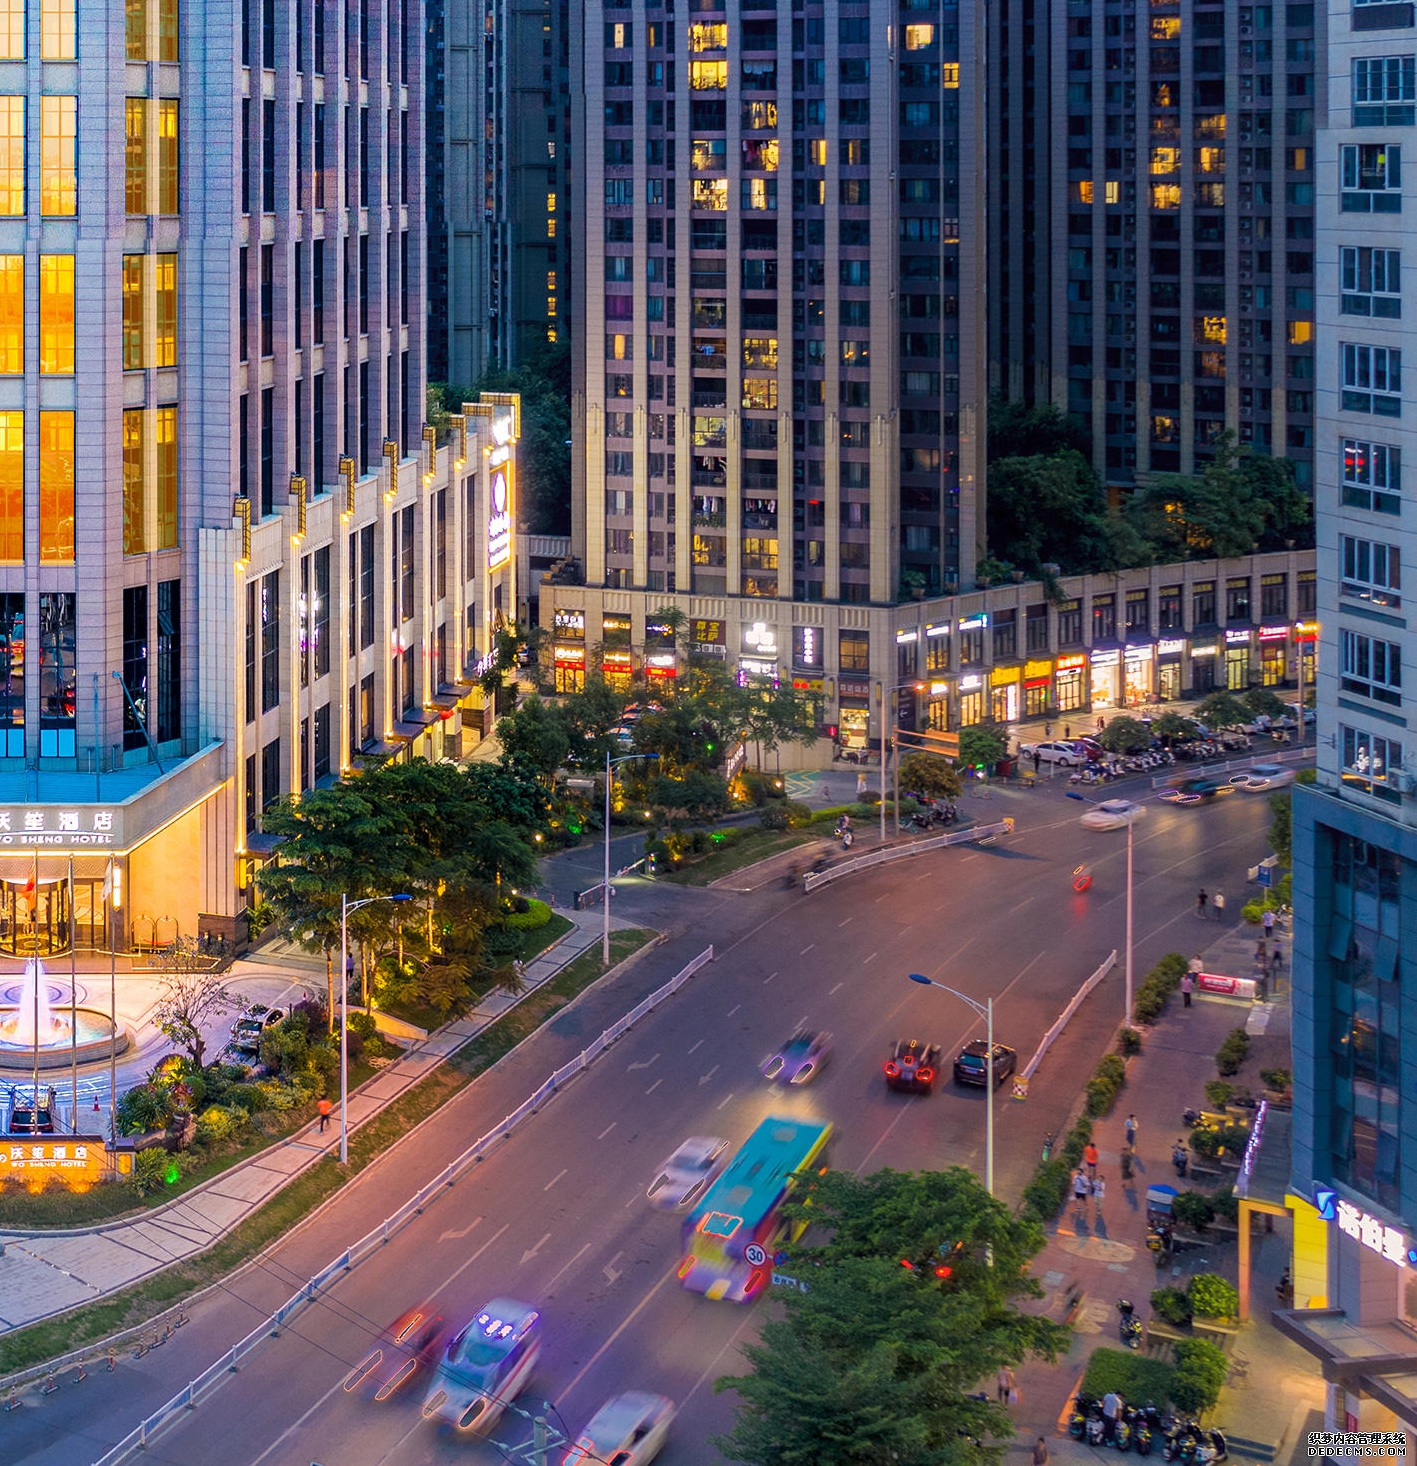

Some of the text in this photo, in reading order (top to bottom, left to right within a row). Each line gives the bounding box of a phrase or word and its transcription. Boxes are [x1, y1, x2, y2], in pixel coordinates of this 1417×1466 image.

[696, 621, 720, 632] 尊宝
[696, 632, 719, 641] 比萨
[21, 835, 63, 844] SHENG
[71, 835, 112, 844] HOTEL
[10, 1145, 88, 1160] 沃笙酒店
[748, 1247, 763, 1262] 30
